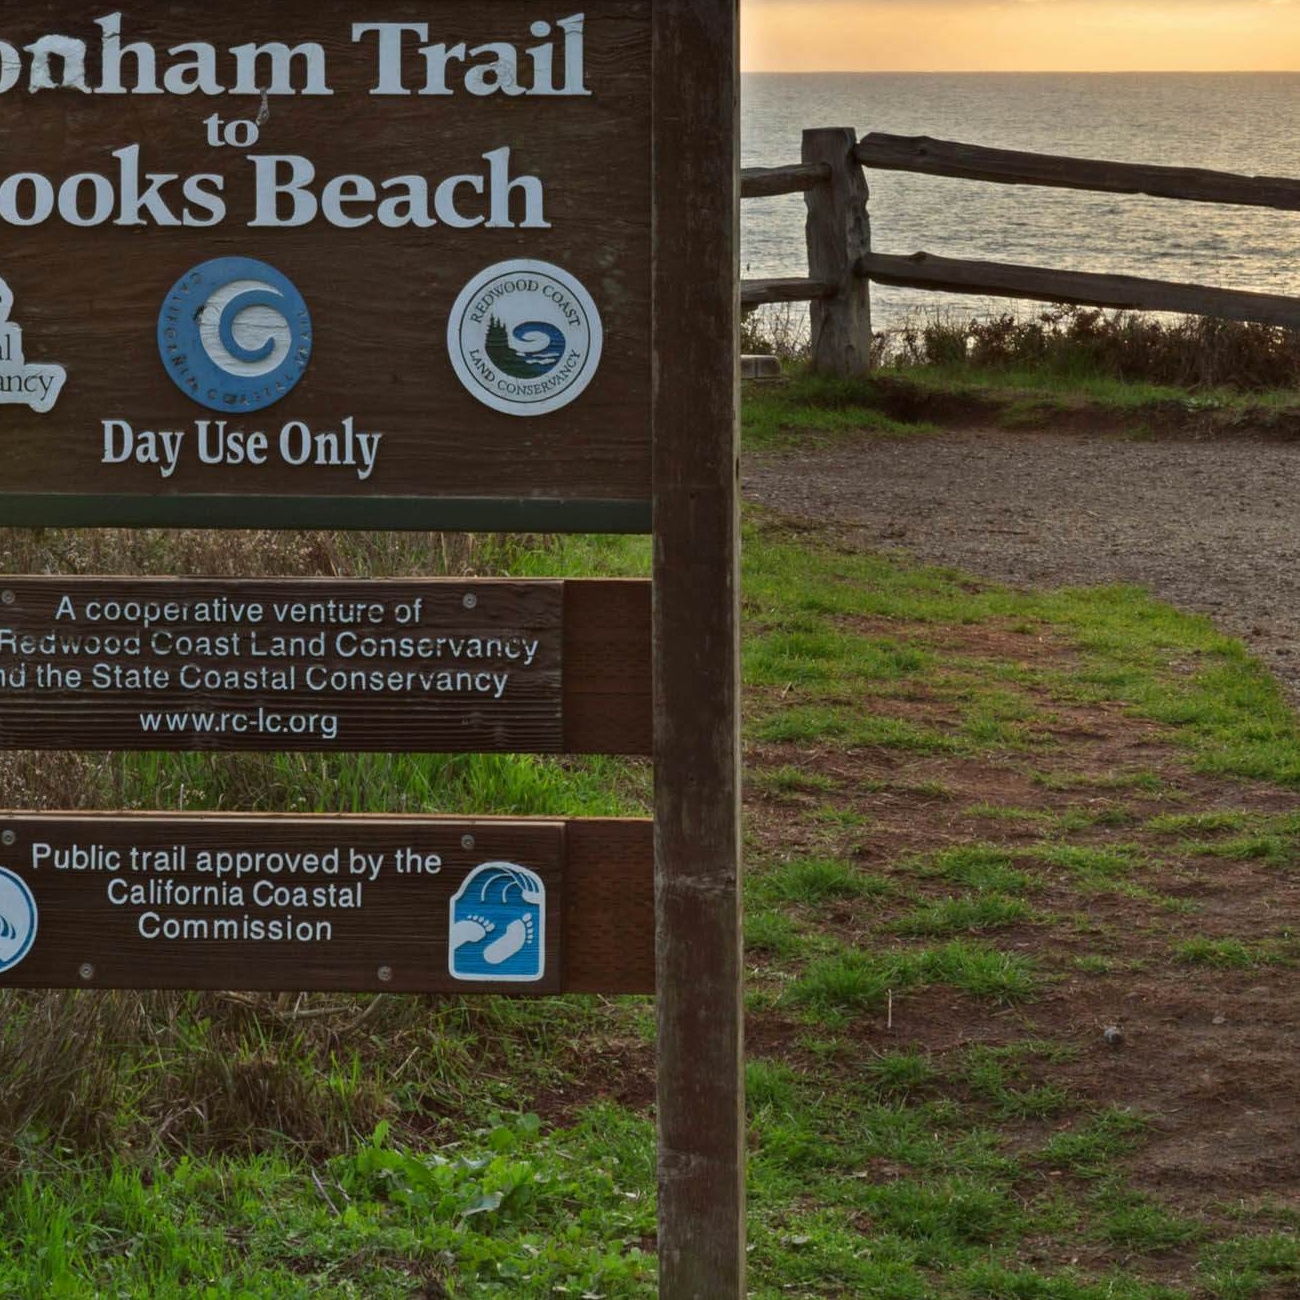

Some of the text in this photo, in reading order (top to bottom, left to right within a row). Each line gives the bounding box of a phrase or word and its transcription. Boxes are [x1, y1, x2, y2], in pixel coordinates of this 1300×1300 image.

[352, 12, 591, 96] Trail
[203, 112, 259, 147] to
[246, 145, 552, 228] Beach
[470, 278, 581, 327] REDWOOD COAST
[469, 349, 581, 397] LAND CONSERVANCY
[101, 416, 382, 479] Day Use Only
[55, 595, 422, 629] A cooperative venture of
[151, 630, 240, 656] Coast
[251, 631, 326, 657] Land
[335, 631, 538, 666] Conservancy
[36, 663, 82, 689] the
[92, 663, 170, 689] State
[180, 664, 296, 691] Coastal
[306, 666, 508, 698] Conservancy
[139, 707, 337, 739] www.rc-lc.org
[32, 843, 442, 881] Public trail approved by the
[108, 878, 362, 908] California Coastal
[138, 912, 332, 941] Commission
